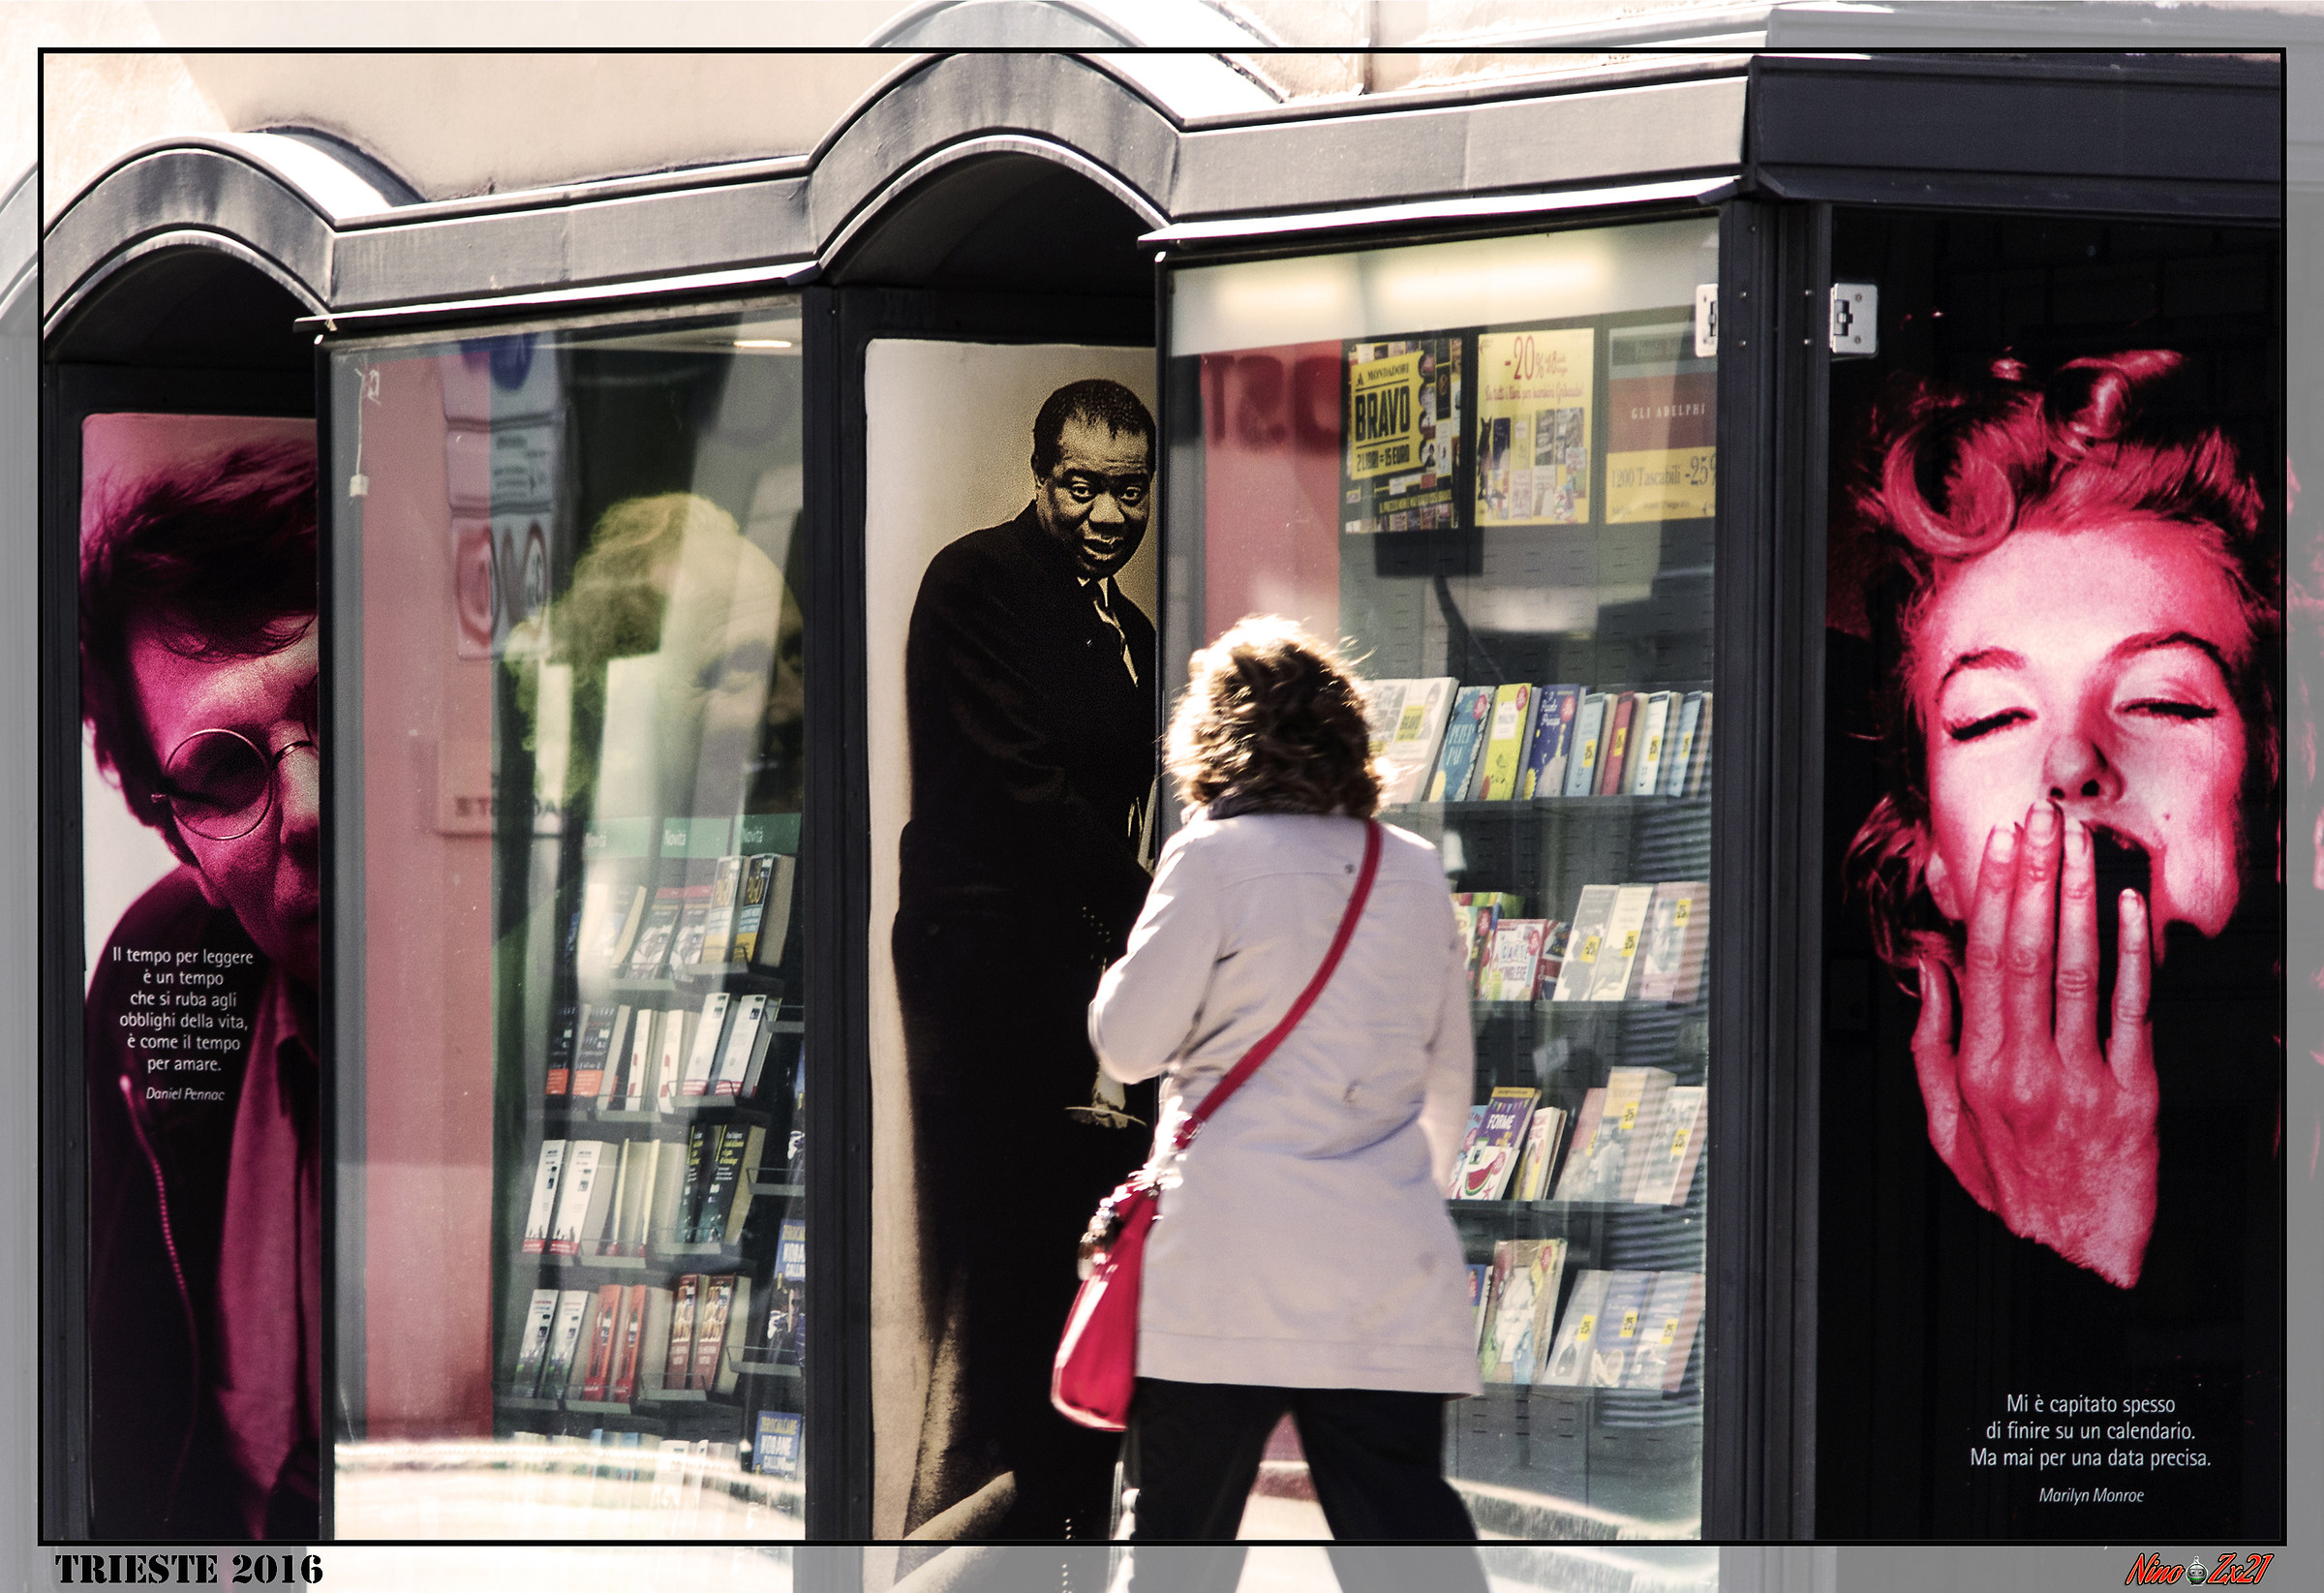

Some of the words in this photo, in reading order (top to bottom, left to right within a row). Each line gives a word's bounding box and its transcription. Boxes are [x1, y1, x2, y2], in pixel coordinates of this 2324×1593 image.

[1504, 335, 1544, 380] -20%
[1367, 362, 1409, 381] MONDADORI
[1355, 385, 1410, 442] BRAVO
[1631, 407, 1651, 419] GLI
[1656, 403, 1705, 418] ADELPHI
[1357, 453, 1361, 473] 2
[1385, 447, 1391, 466] 15
[1392, 444, 1410, 465] EURO
[1611, 469, 1635, 489] 1200
[1636, 464, 1681, 487] Tascabili
[113, 946, 121, 962] Il
[127, 949, 171, 966] tempo
[176, 951, 199, 966] per
[203, 949, 254, 967] leggere
[143, 969, 152, 984] è
[156, 973, 173, 984] un
[180, 972, 224, 989] tempo
[130, 991, 155, 1005] che
[160, 991, 170, 1005] si
[175, 992, 206, 1006] ruba
[211, 993, 237, 1011] agli
[119, 1012, 176, 1030] obblighi
[180, 1014, 213, 1028] della
[218, 1014, 248, 1030] vita,
[127, 1033, 136, 1049] è
[140, 1037, 178, 1049] come
[183, 1034, 191, 1049] il
[197, 1036, 240, 1054] tempo
[147, 1058, 170, 1073] per
[174, 1058, 222, 1072] amare.
[146, 1087, 181, 1100] Daniel
[184, 1088, 225, 1101] Pennac
[1487, 1114, 1515, 1130] FORME
[2006, 1394, 2029, 1413] Mi
[2034, 1394, 2044, 1413] è
[2049, 1394, 2118, 1418] capitato
[2123, 1398, 2176, 1418] spesso
[1986, 1421, 2002, 1440] di
[2006, 1421, 2050, 1440] finire
[2056, 1425, 2073, 1440] su
[2080, 1425, 2101, 1440] un
[2107, 1421, 2196, 1440] calendario.
[1971, 1447, 1997, 1466] Ma
[2003, 1448, 2034, 1466] mai
[2039, 1452, 2066, 1471] per
[2071, 1452, 2102, 1466] una
[2108, 1448, 2144, 1466] data
[2151, 1448, 2212, 1471] precisa.
[2038, 1487, 2090, 1506] Marilyn
[2093, 1487, 2145, 1502] Monroe
